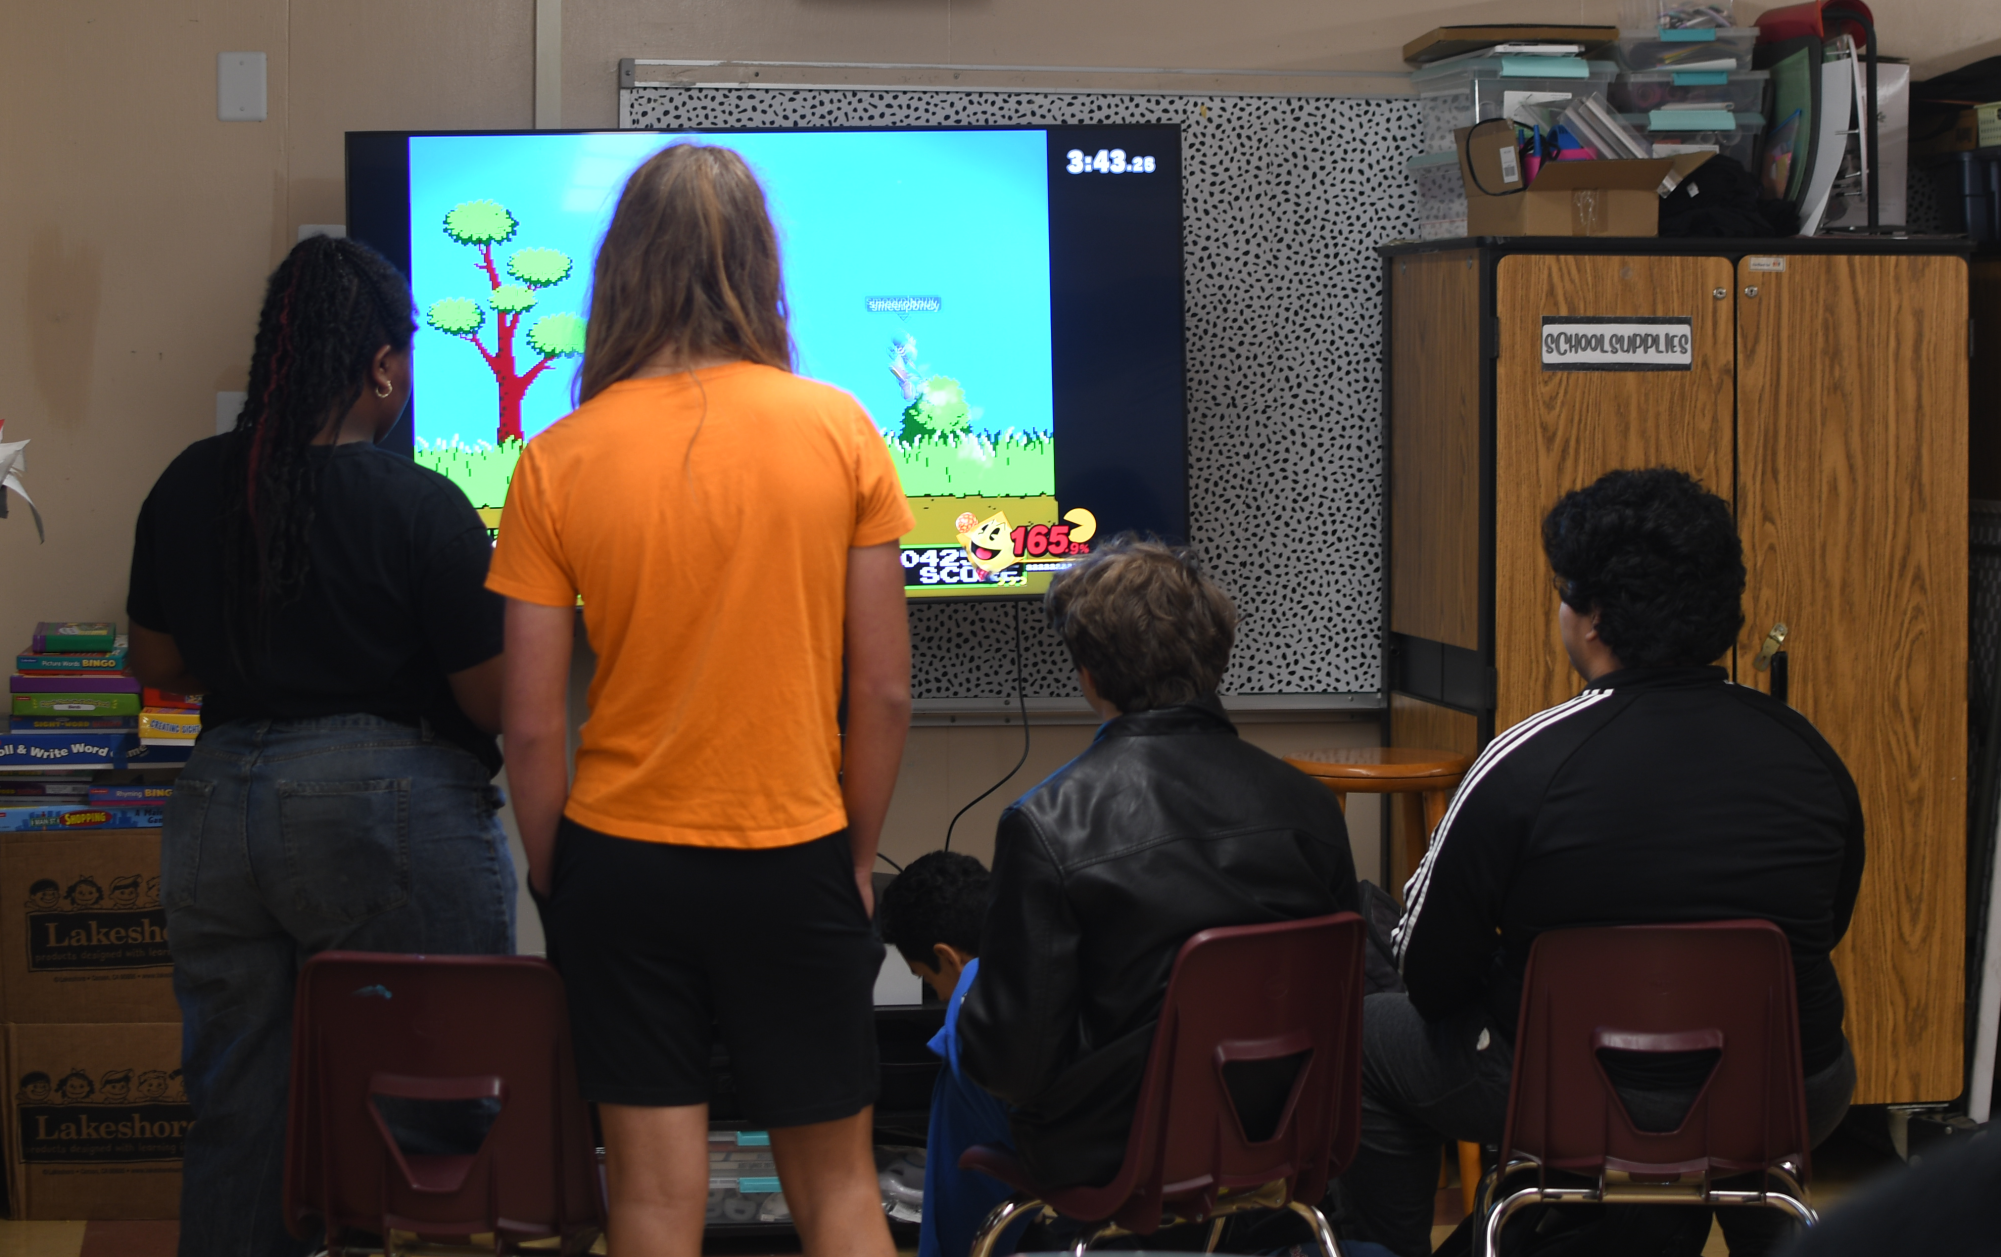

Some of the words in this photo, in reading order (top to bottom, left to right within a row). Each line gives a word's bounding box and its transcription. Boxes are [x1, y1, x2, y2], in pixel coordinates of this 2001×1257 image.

[1544, 332, 1609, 356] SCHOOL
[1609, 333, 1689, 354] SUPPLIES
[42, 660, 61, 668] Picture
[62, 660, 80, 668] Words
[82, 659, 116, 669] BINGO
[150, 718, 180, 734] CREATING
[16, 744, 28, 755] &
[30, 746, 69, 759] Write
[70, 743, 109, 757] Word
[116, 790, 143, 799] Rhyming
[64, 812, 107, 825] SHOPPING
[35, 952, 77, 964] products
[81, 950, 122, 962] designed
[126, 948, 146, 957] with
[35, 1113, 198, 1141] Lakeshor
[26, 1145, 67, 1155] products
[70, 1143, 112, 1156] designed
[115, 1143, 135, 1153] with
[138, 1143, 177, 1154] learning
